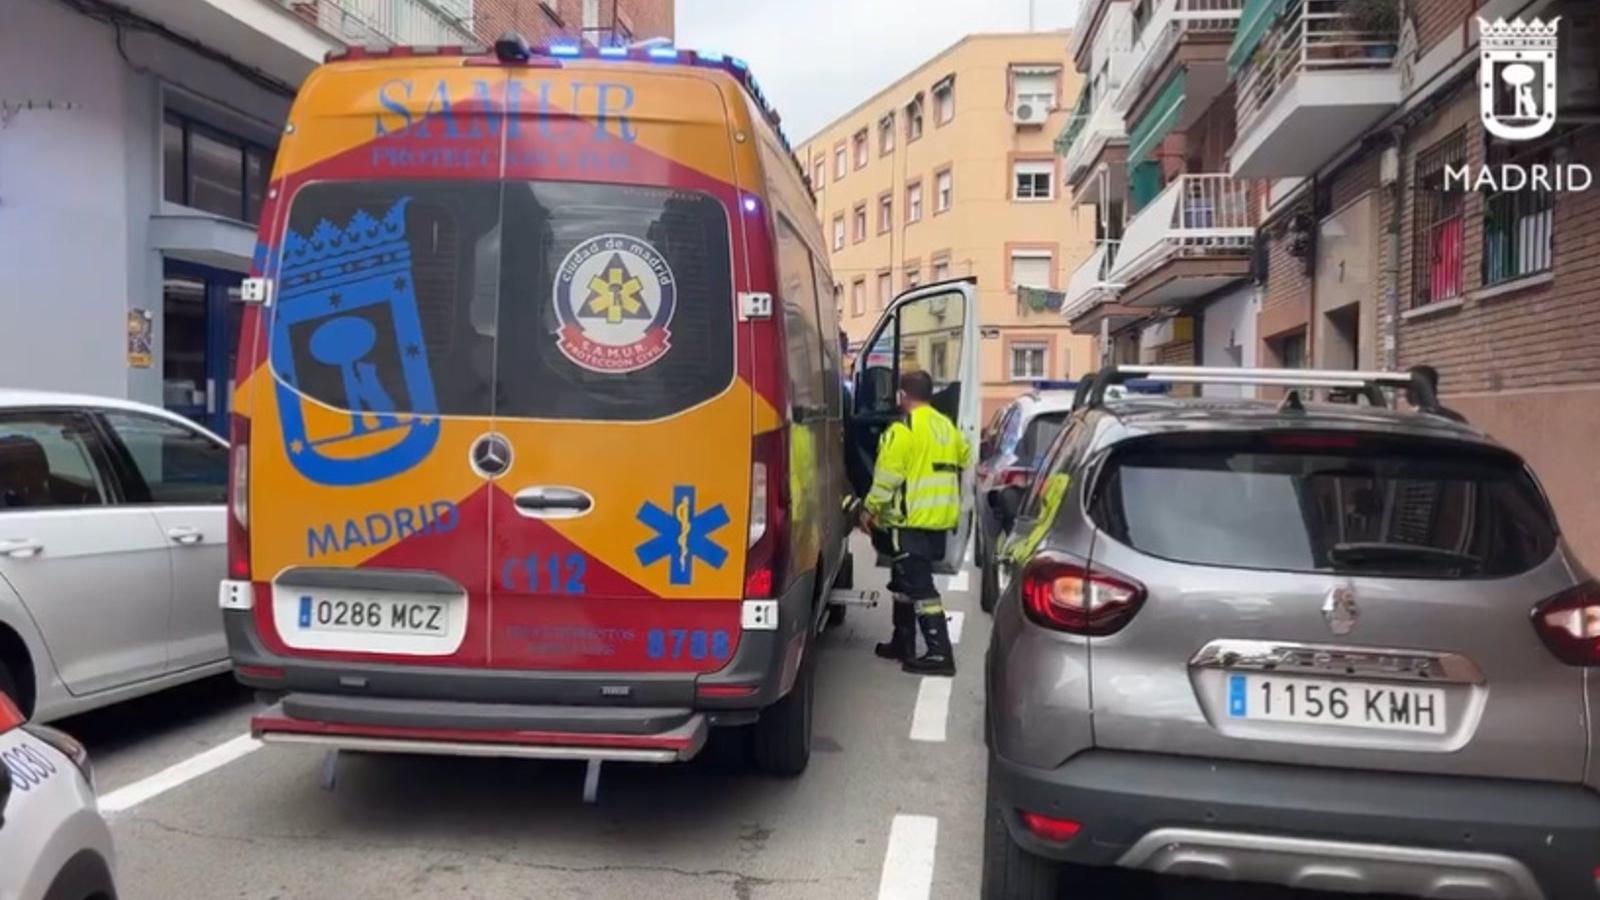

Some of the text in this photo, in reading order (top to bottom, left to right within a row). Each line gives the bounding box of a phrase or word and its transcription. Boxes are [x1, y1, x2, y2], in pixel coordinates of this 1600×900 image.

[375, 79, 638, 143] SAMUR
[562, 238, 672, 286] ciudad de madrid
[306, 500, 460, 558] MADRID
[525, 553, 586, 595] 112
[317, 600, 443, 631] 0286 MCZ
[1261, 681, 1435, 727] 1156 KMH
